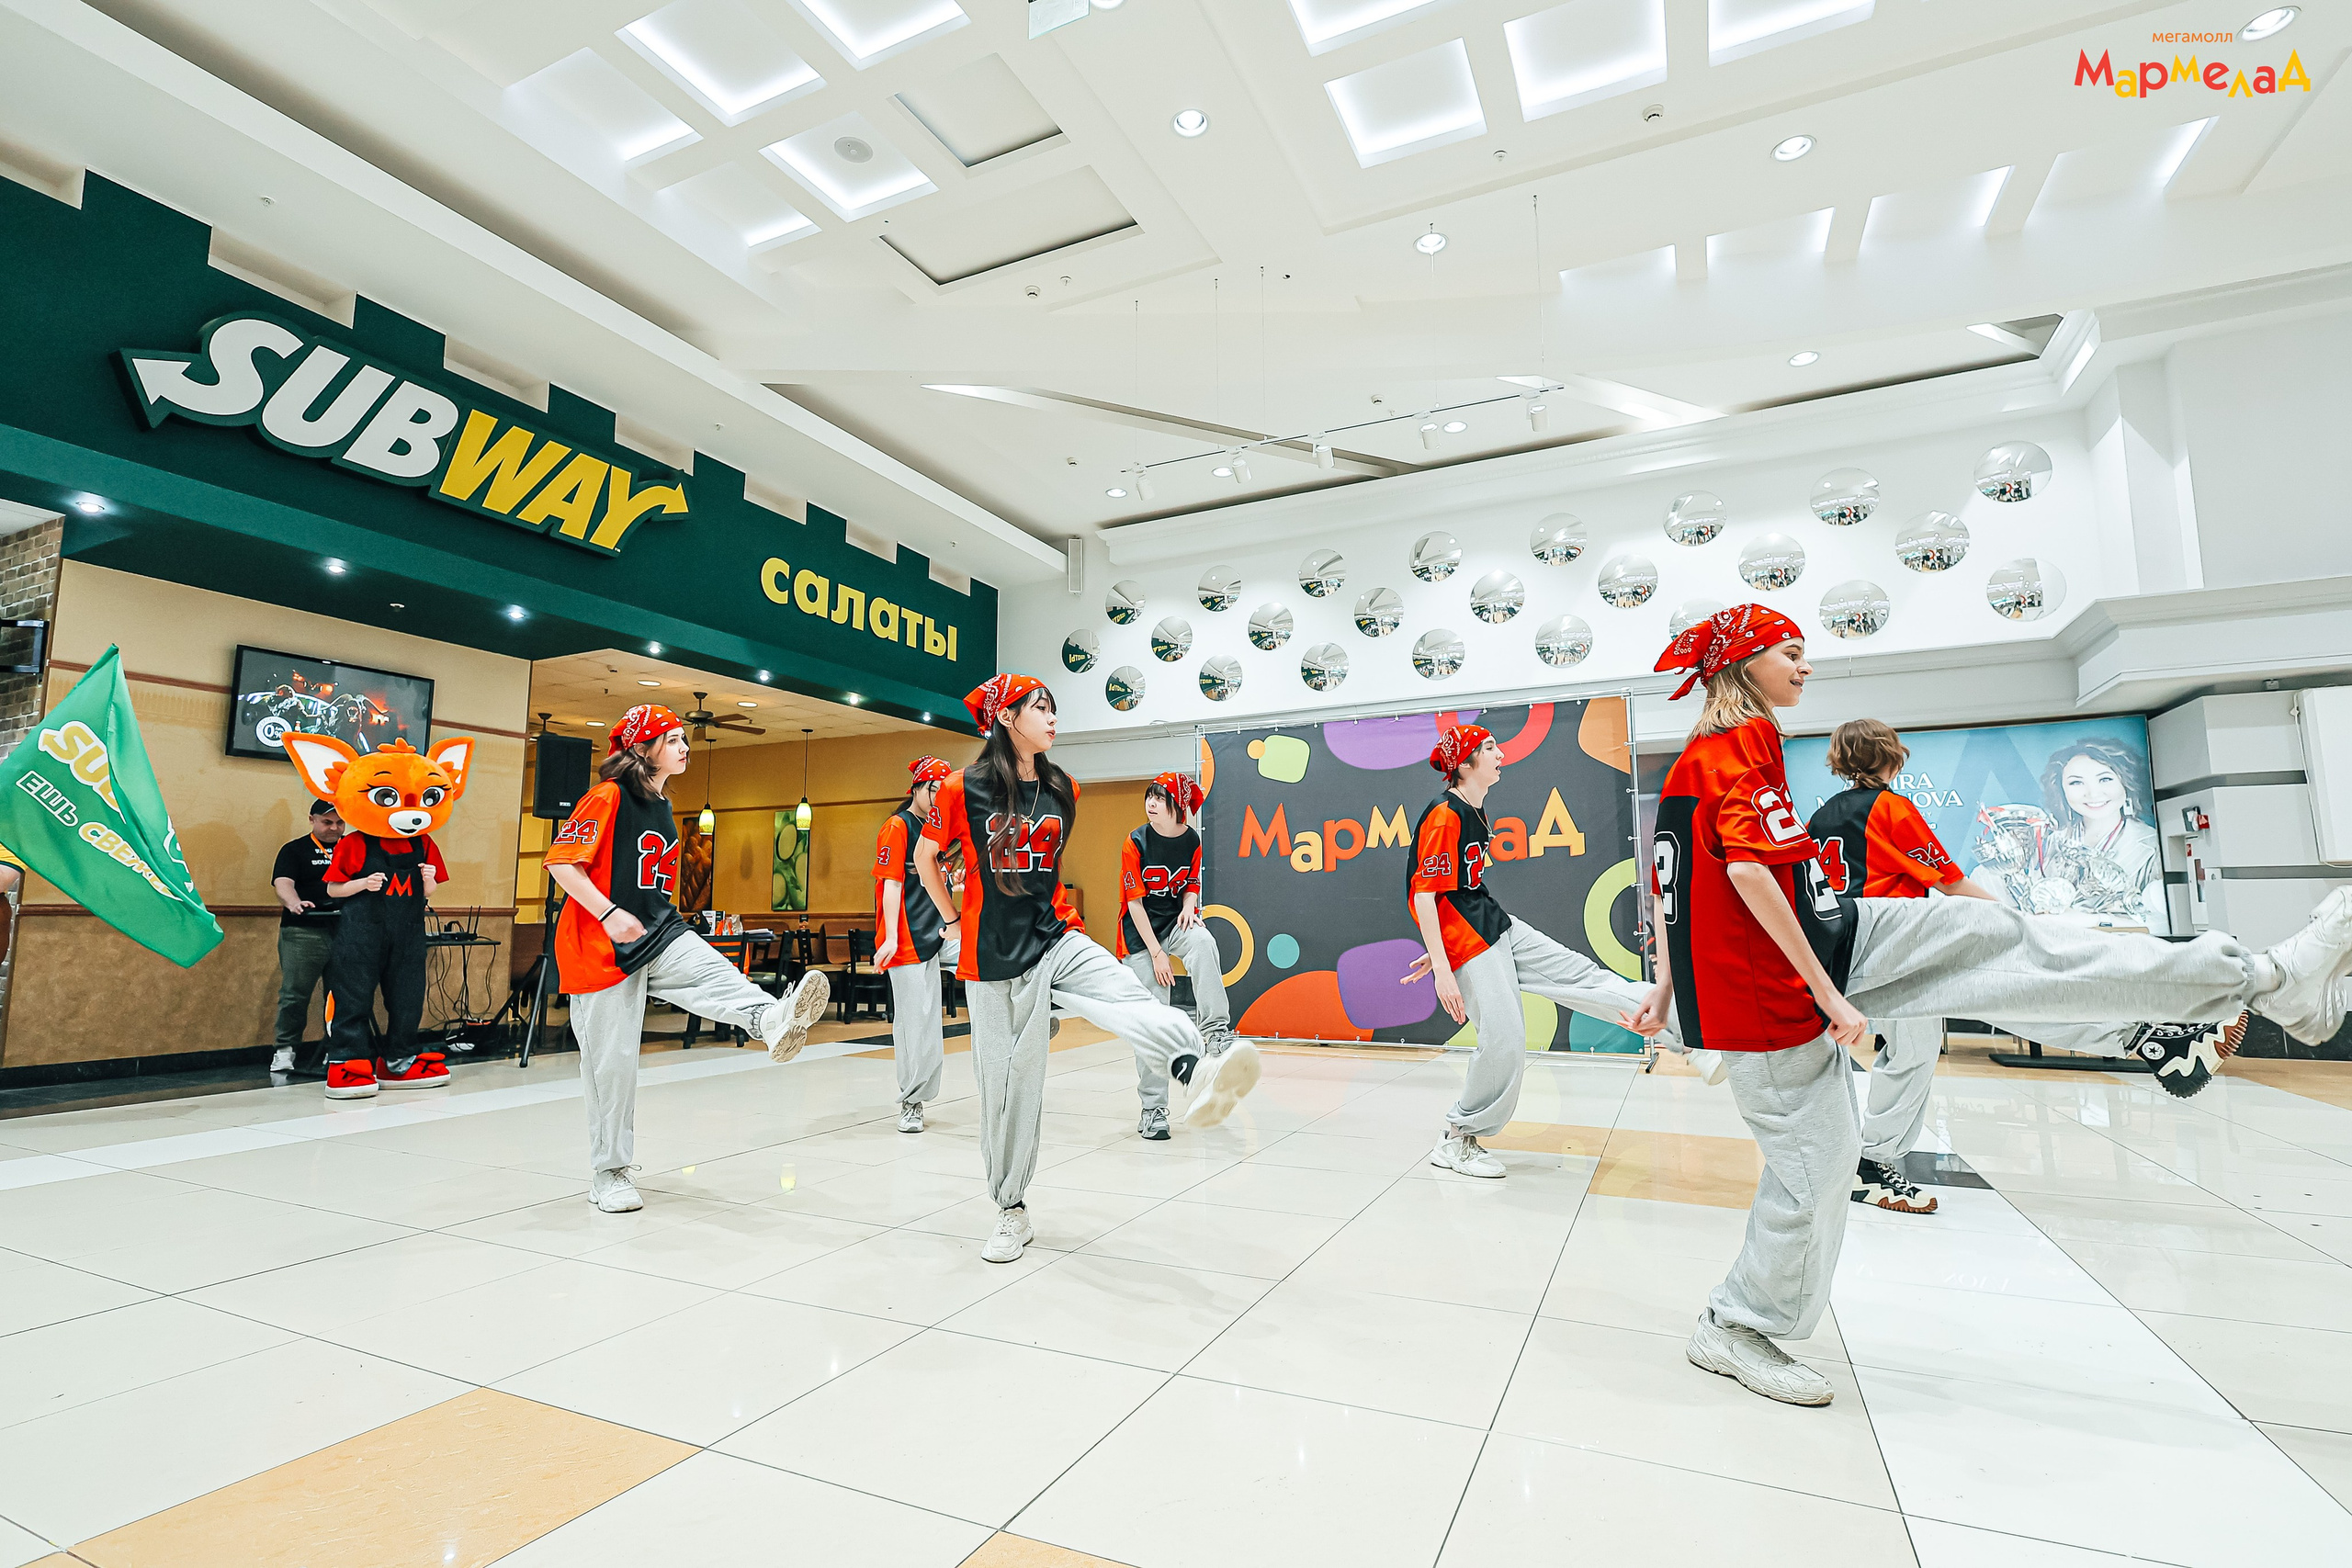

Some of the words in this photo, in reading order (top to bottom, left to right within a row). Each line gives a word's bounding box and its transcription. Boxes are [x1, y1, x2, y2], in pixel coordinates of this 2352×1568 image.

[131, 318, 690, 551] SUBWAY
[761, 557, 957, 662] салаты
[16, 770, 79, 827] ЕШЬ
[553, 819, 598, 844] 24
[986, 812, 1063, 873] 24
[1238, 786, 1587, 873] Мармад
[638, 830, 679, 897] 24
[1421, 852, 1452, 878] 24
[1813, 836, 1850, 896] 4
